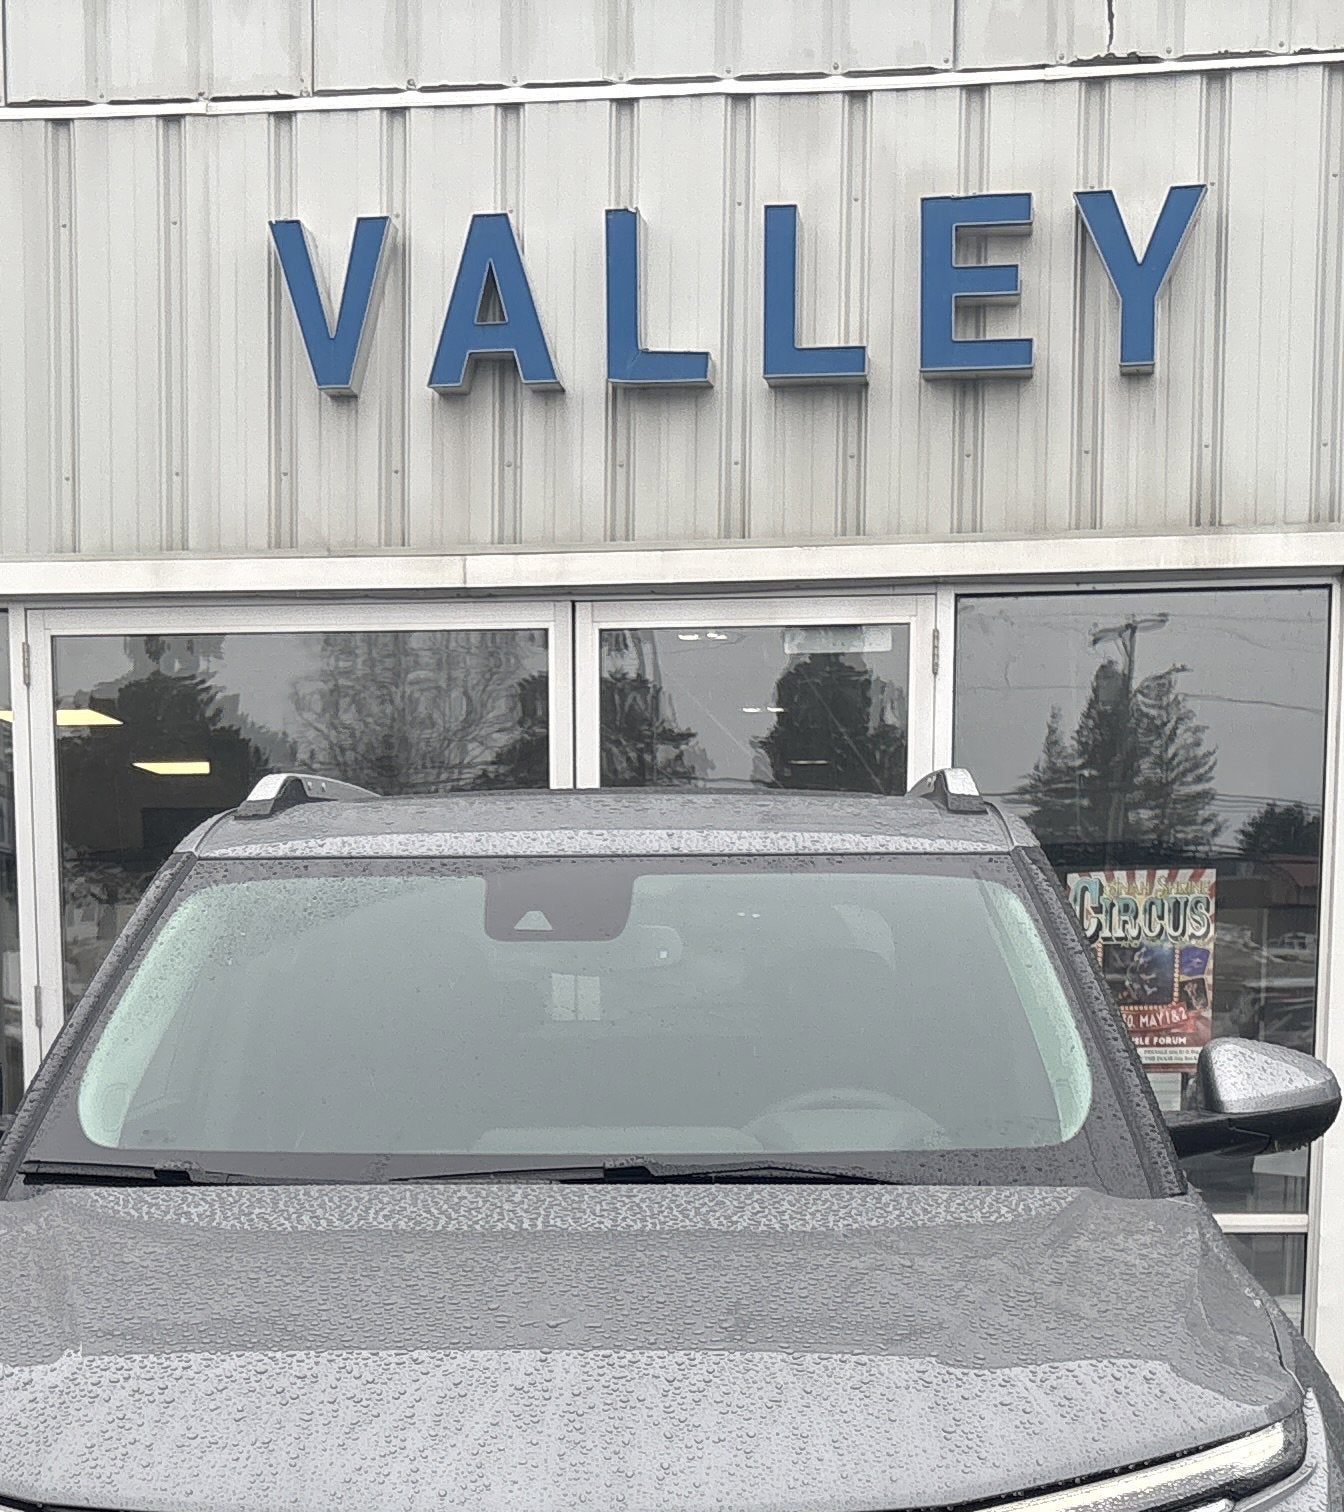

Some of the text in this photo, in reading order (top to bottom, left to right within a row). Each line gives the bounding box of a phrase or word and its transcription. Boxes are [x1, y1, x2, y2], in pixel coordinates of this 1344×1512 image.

[267, 183, 1208, 397] VALLEY
[1069, 878, 1212, 941] CIRCUS
[1140, 1011, 1163, 1028] MAY
[1153, 1036, 1187, 1046] FORUM
